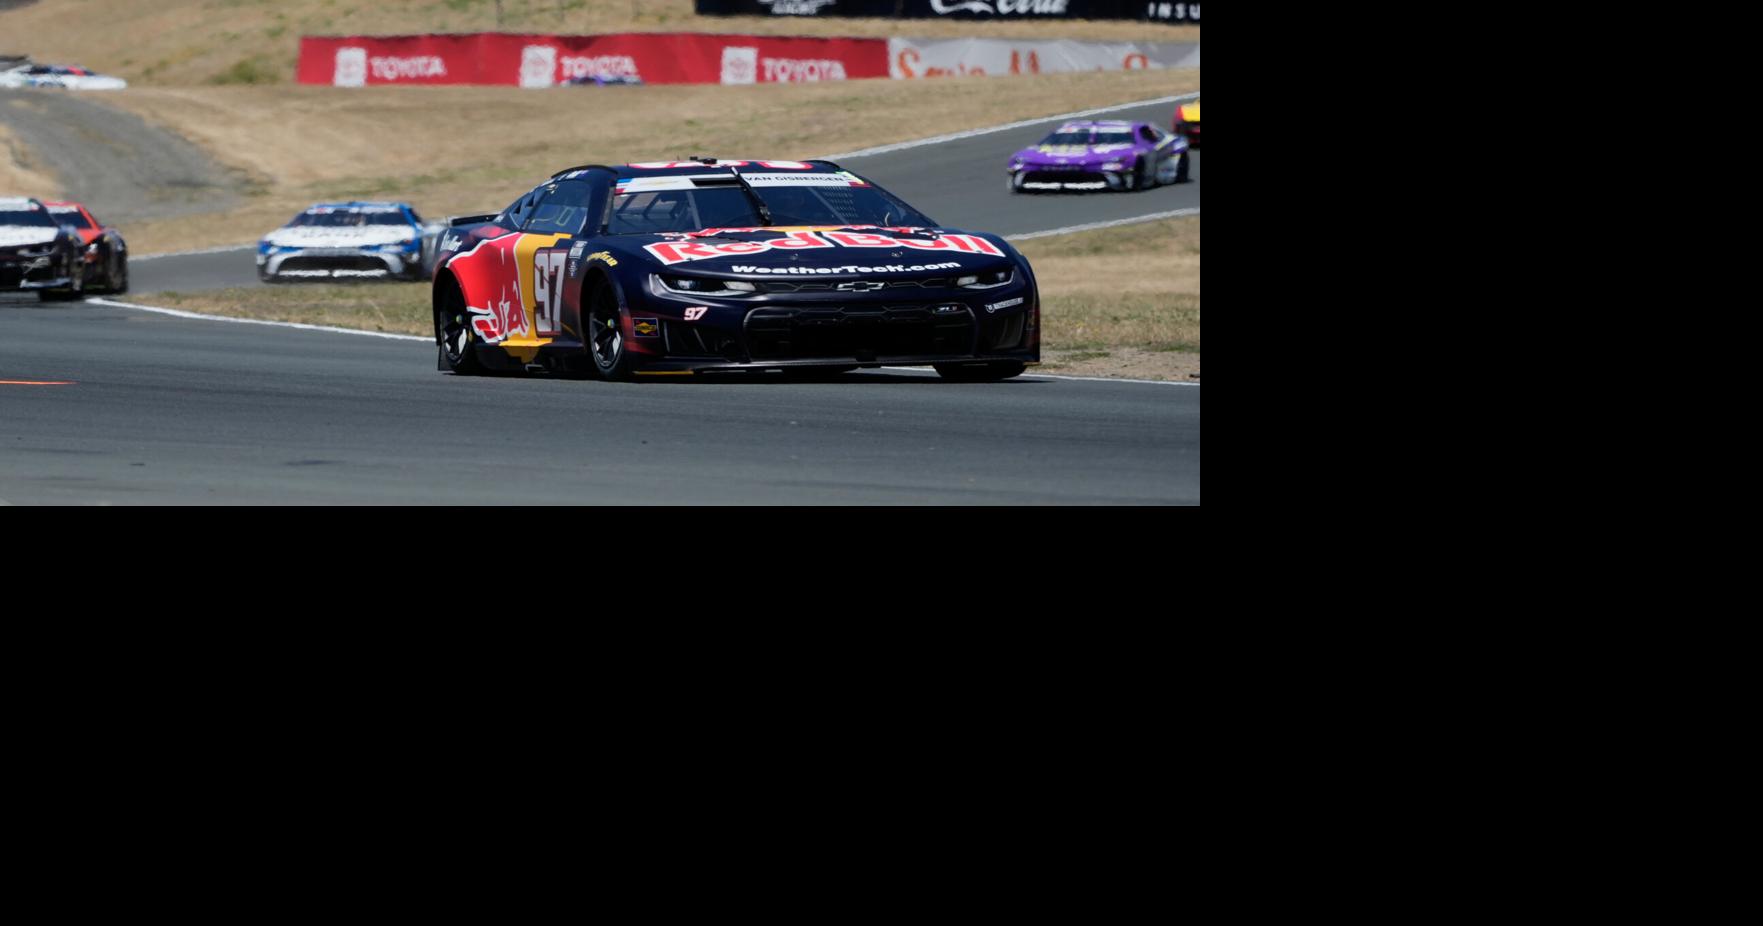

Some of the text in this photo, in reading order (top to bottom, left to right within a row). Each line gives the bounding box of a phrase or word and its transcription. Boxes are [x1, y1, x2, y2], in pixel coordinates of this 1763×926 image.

[370, 56, 447, 79] TOYOTA
[762, 58, 847, 81] TOYOTA
[643, 231, 1006, 265] Red Bull
[731, 262, 961, 274] WeatherTech.com
[534, 250, 568, 334] 97
[683, 306, 708, 321] 97
